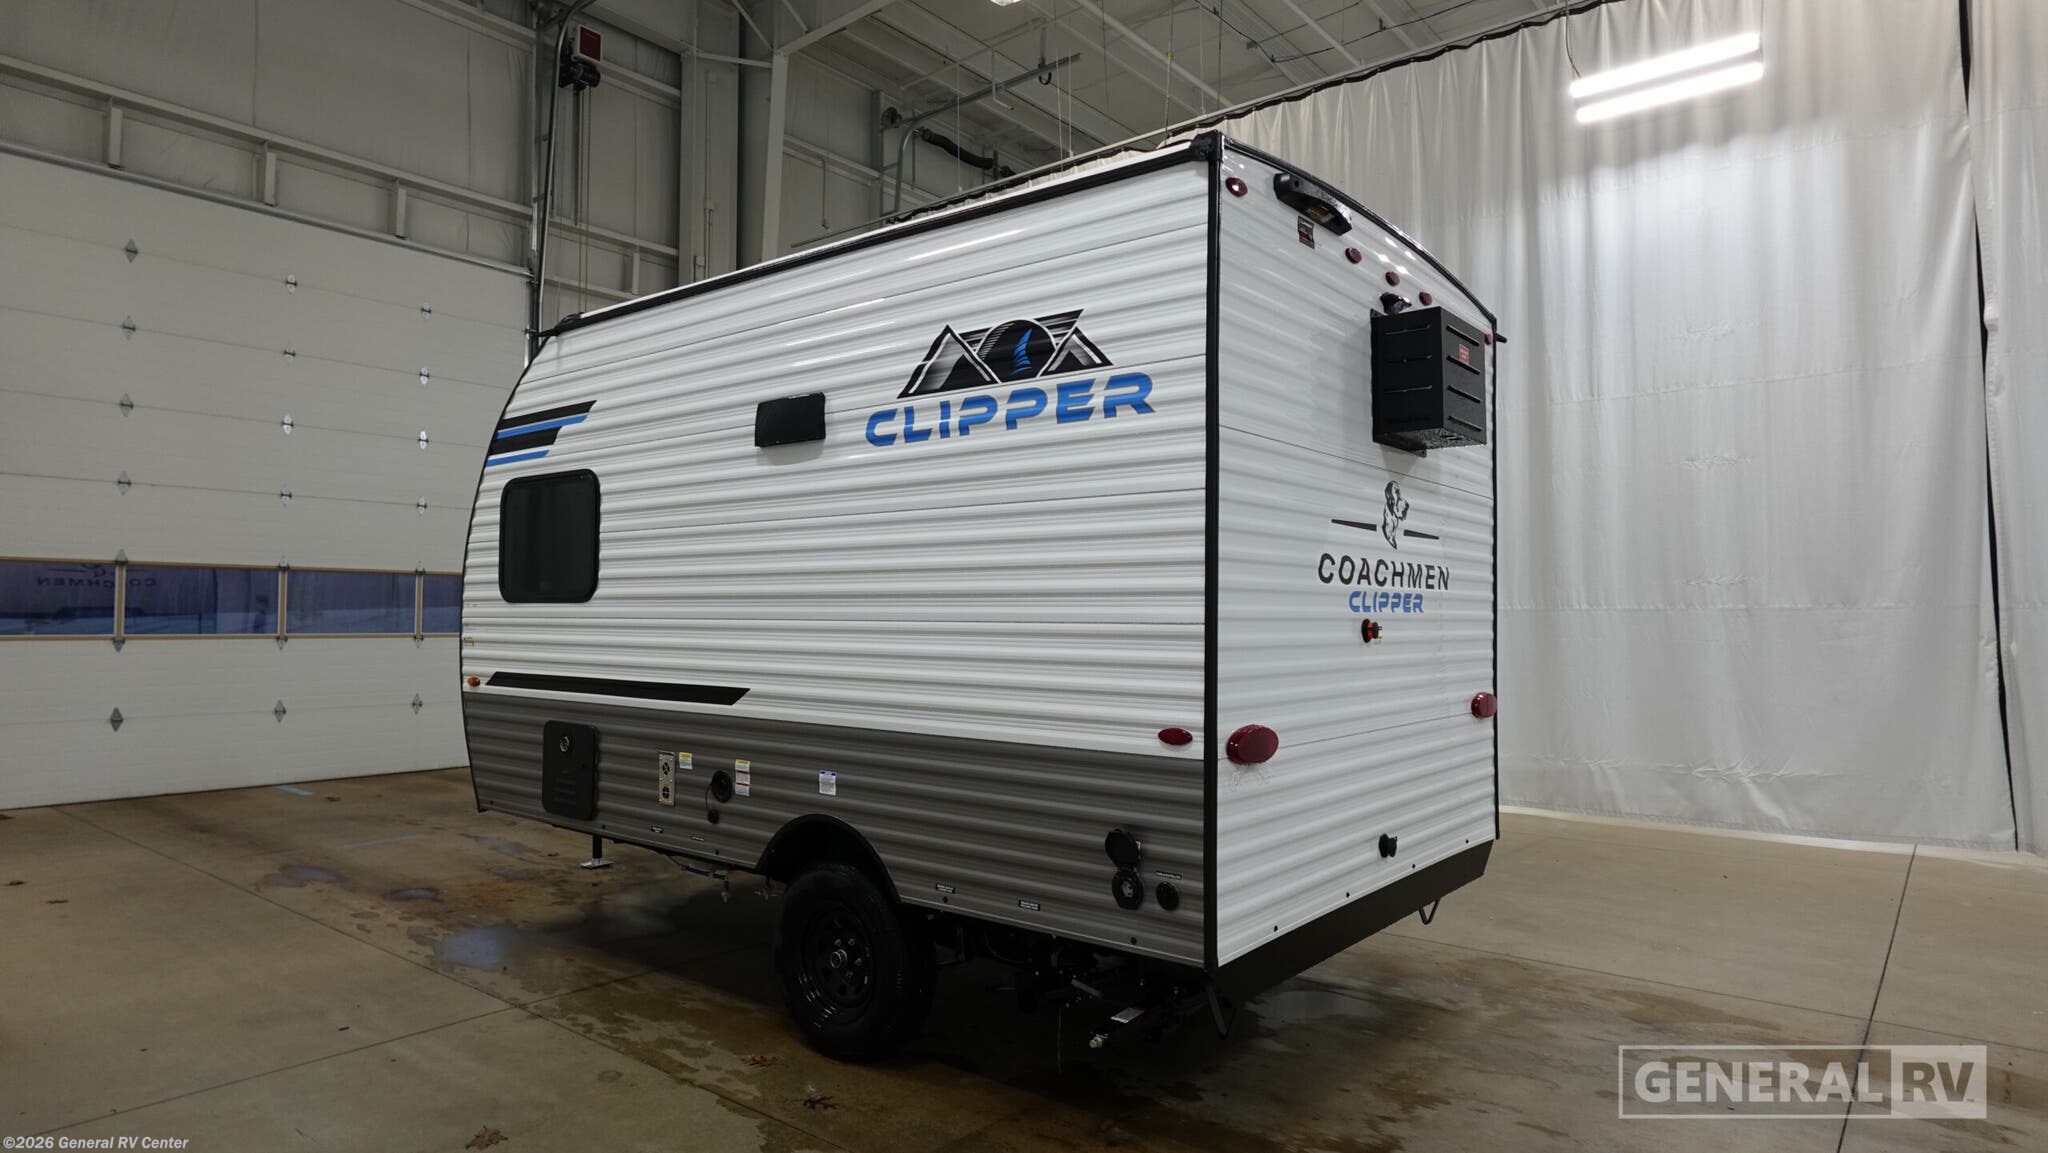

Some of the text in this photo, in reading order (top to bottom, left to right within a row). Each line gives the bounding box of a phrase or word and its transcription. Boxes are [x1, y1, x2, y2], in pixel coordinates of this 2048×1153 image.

[866, 372, 1156, 447] CLIPPER
[1318, 553, 1450, 590] COACHMEN
[1349, 591, 1424, 613] CLIPPER
